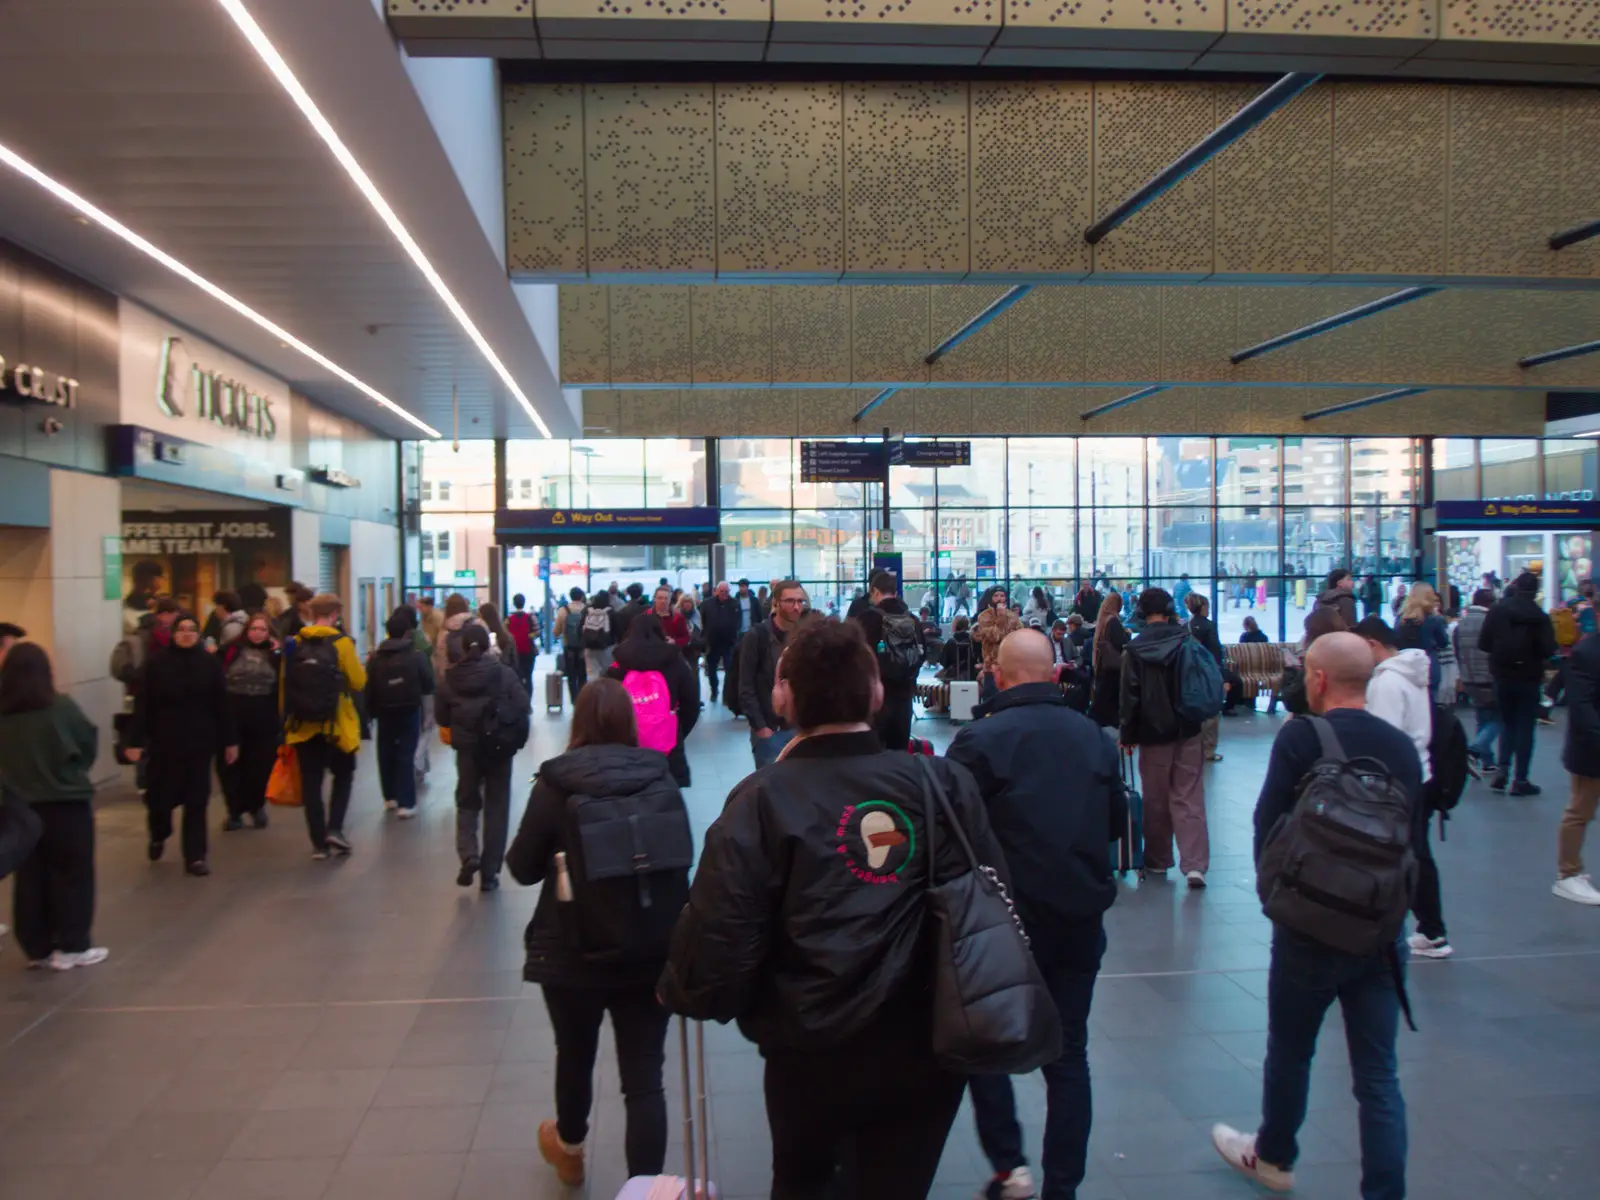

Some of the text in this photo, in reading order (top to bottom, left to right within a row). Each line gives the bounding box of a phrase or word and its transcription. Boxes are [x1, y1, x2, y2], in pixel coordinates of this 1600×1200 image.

[14, 363, 80, 409] CRUST
[571, 512, 592, 523] Way
[594, 511, 613, 521] Out
[216, 523, 276, 538] JOBS.
[164, 539, 230, 554] TEAM.
